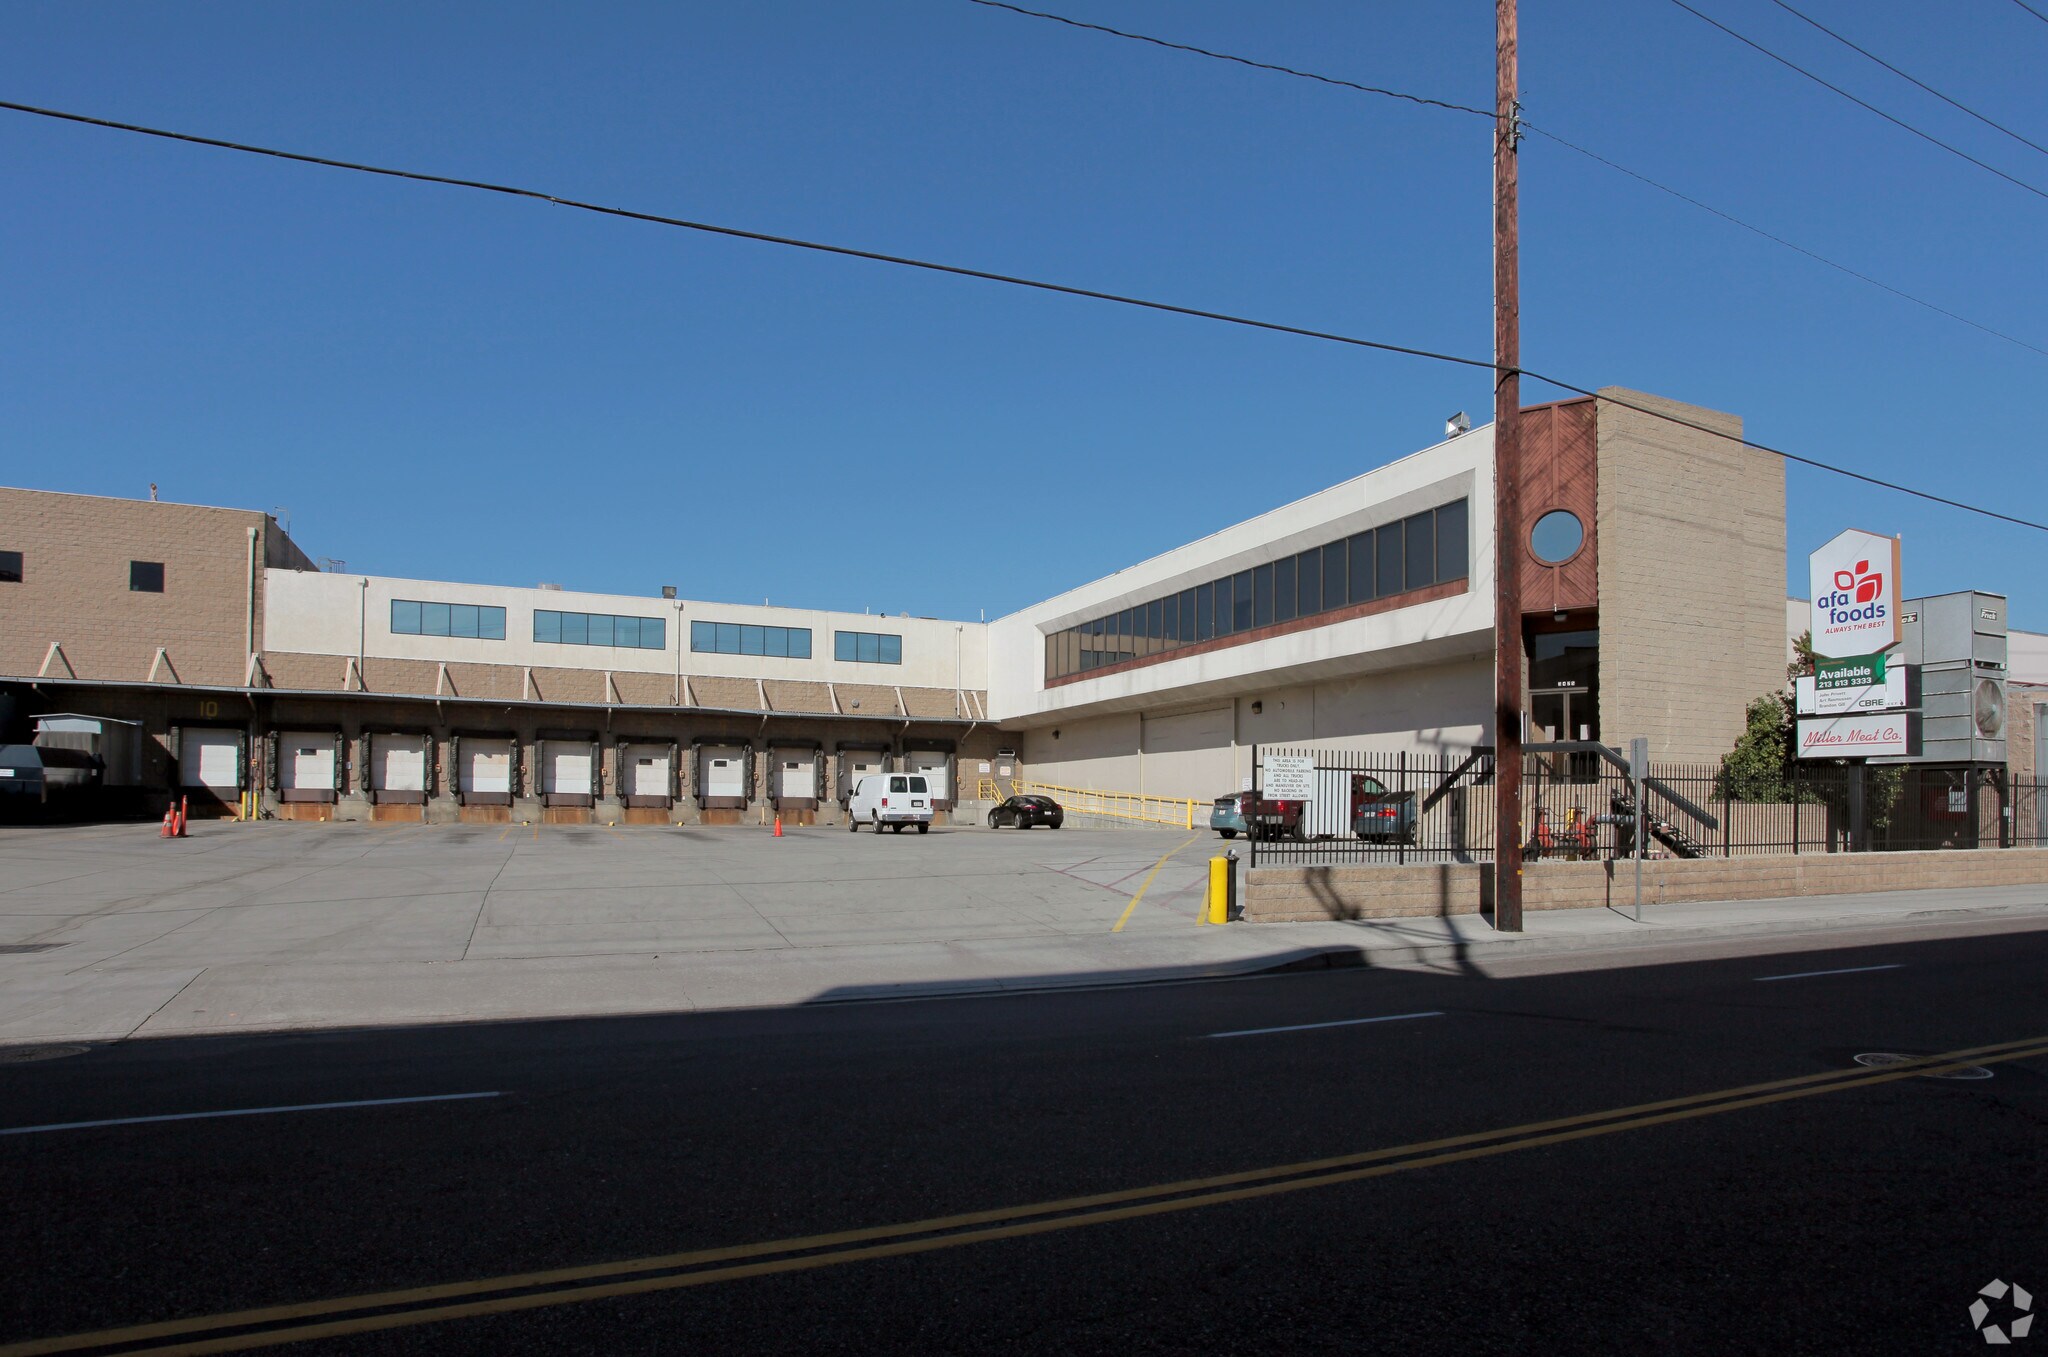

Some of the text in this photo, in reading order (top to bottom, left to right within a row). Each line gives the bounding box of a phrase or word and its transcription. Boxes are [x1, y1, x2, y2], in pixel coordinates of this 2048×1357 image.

[1817, 591, 1849, 609] afa
[1829, 602, 1886, 625] foods
[1824, 620, 1886, 635] ALWAYS THE BEST
[1818, 666, 1871, 680] Available
[1818, 677, 1872, 689] 213 613 3333
[200, 701, 218, 717] 10
[1858, 698, 1884, 707] CBRE
[1804, 727, 1902, 746] Miller Meat Co.
